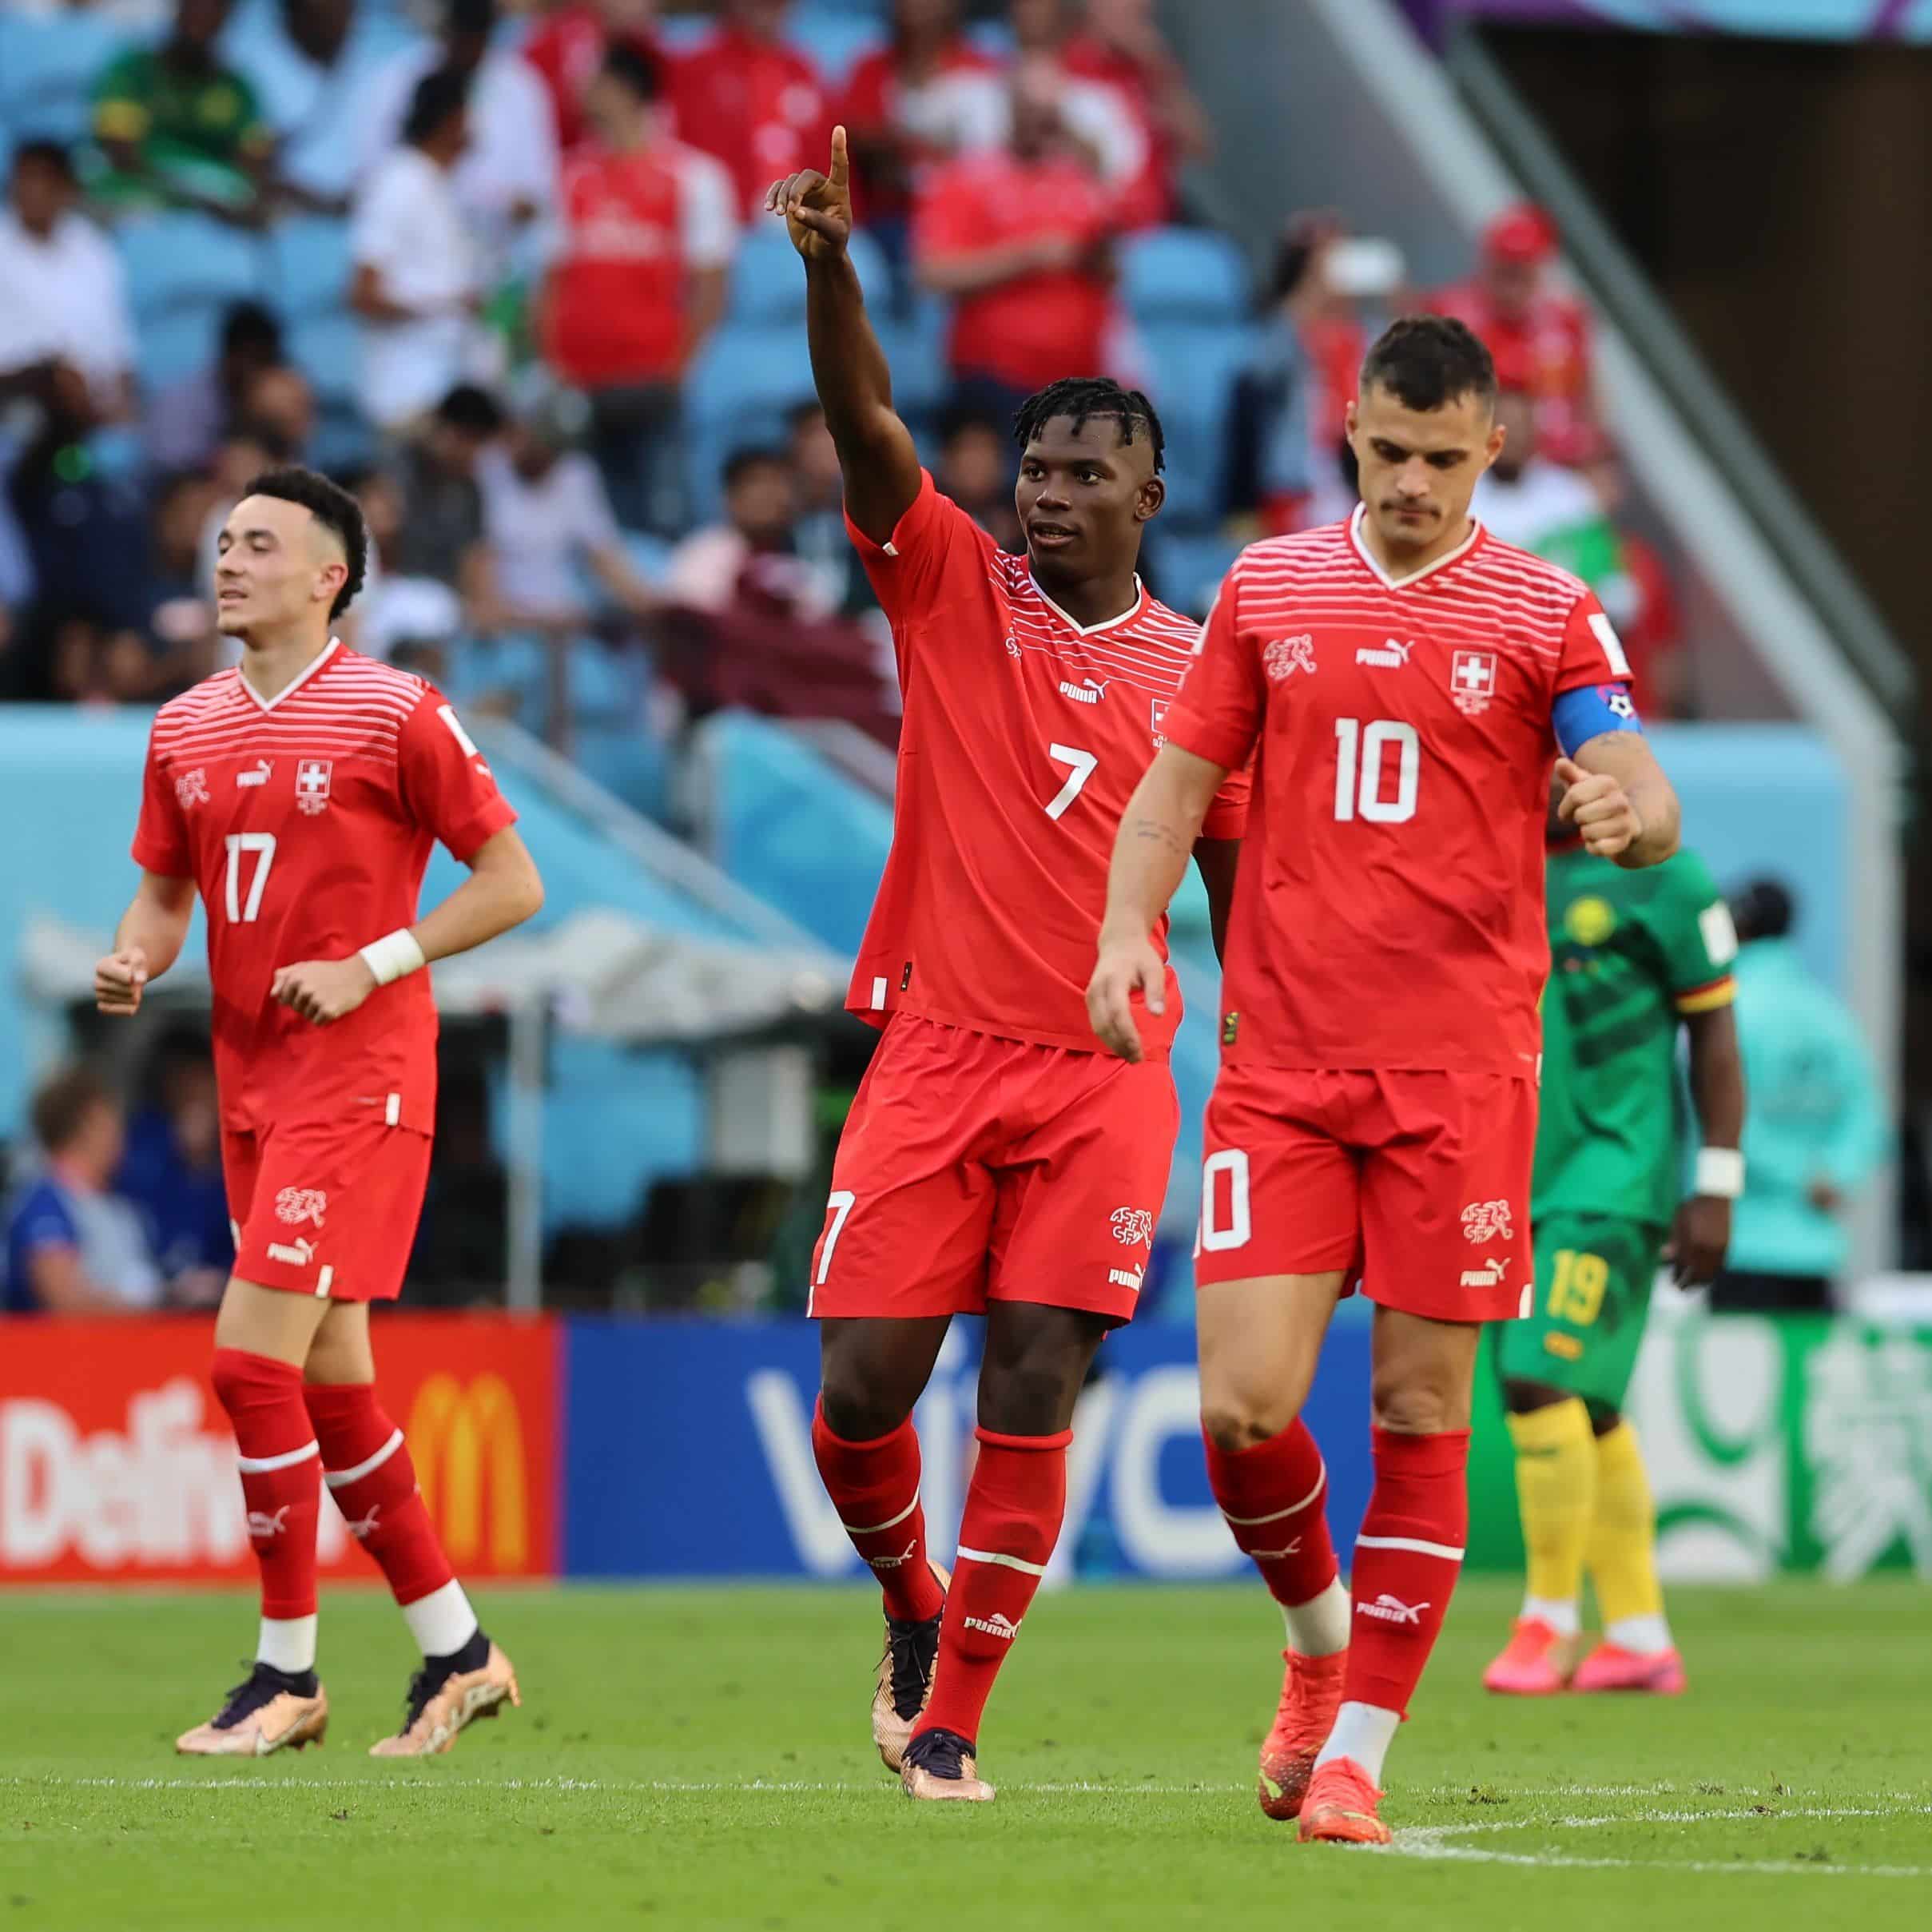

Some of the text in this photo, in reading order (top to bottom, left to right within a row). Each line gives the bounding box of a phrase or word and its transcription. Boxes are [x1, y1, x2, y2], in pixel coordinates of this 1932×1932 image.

[1059, 681, 1097, 704] PUMA
[1044, 741, 1099, 821] 7
[1334, 717, 1421, 824] 10
[225, 832, 277, 924] 17
[816, 1190, 857, 1286] 7
[1547, 1249, 1610, 1329] 19
